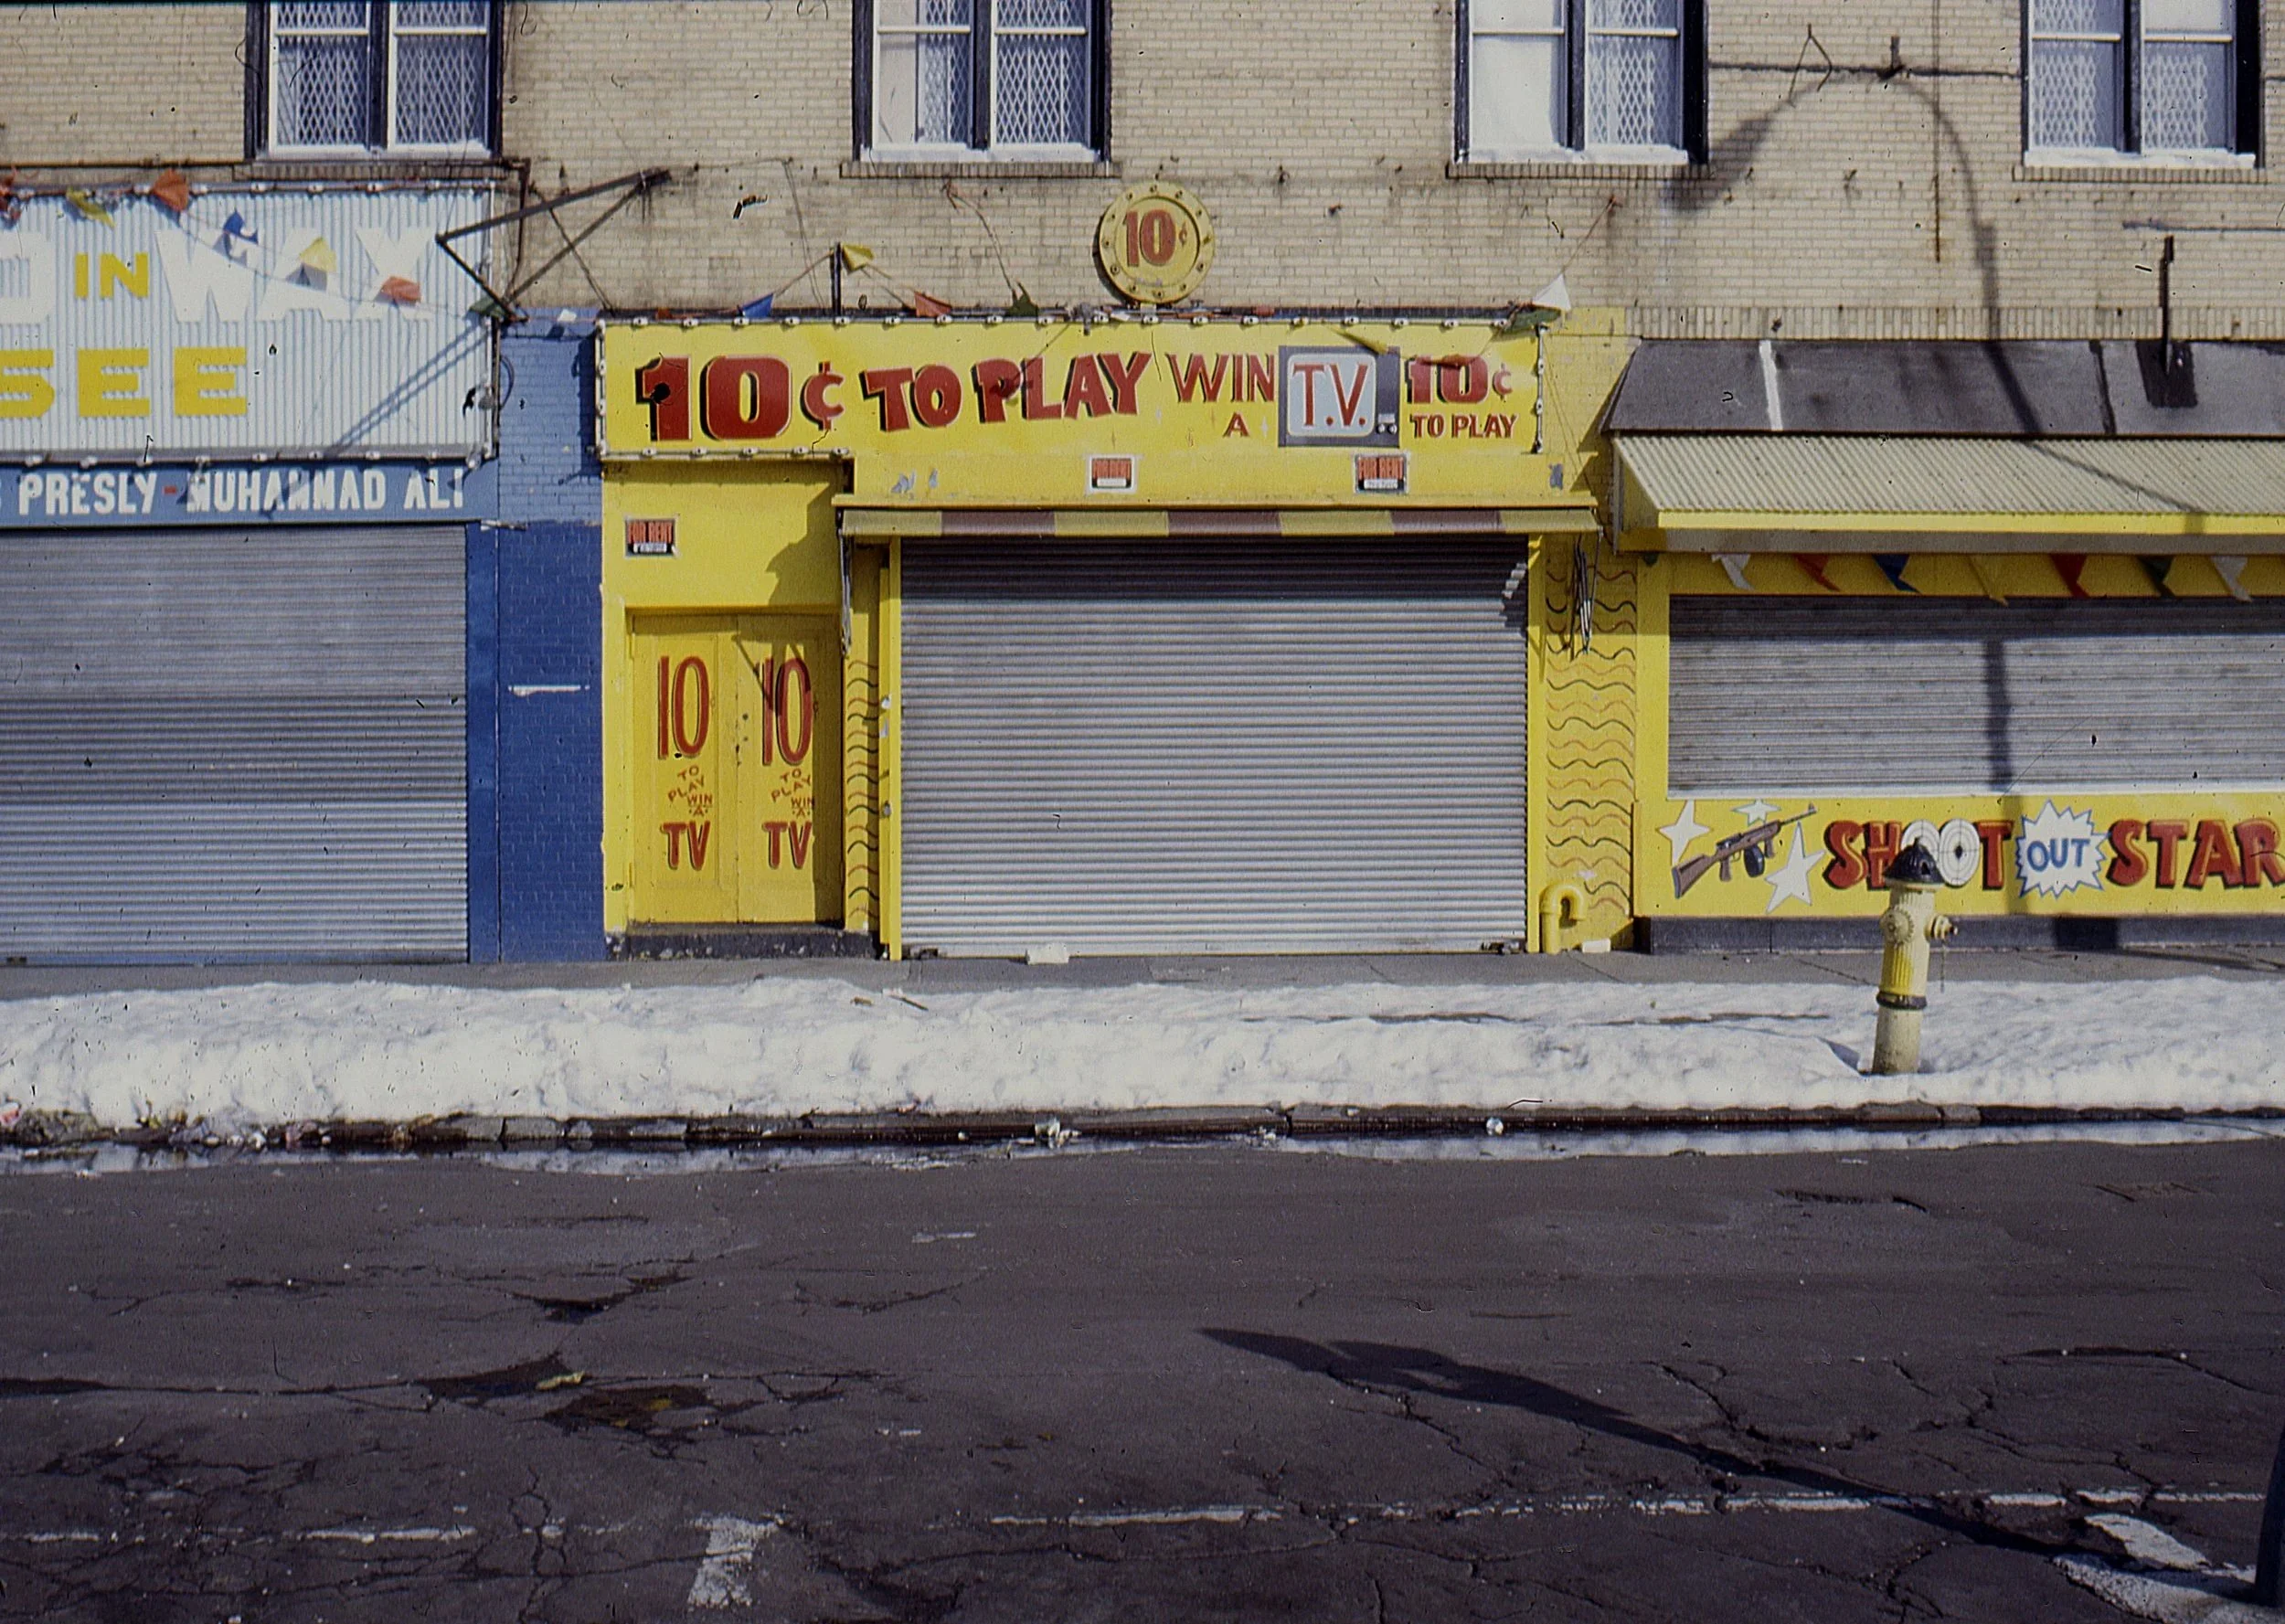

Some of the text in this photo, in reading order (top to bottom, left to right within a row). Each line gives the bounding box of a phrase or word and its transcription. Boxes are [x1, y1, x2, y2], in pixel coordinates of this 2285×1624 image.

[74, 252, 149, 300] IN
[154, 228, 436, 323] WAY
[0, 346, 248, 418] SEE
[635, 350, 1275, 442] 10¢ TO PLAY WIN
[1293, 361, 1368, 429] T.V.
[1223, 411, 1250, 438] A
[1408, 412, 1519, 440] TO PLAY
[18, 471, 157, 517] PRESLY
[186, 467, 387, 514] MUHAMMAD
[403, 466, 463, 509] ALI
[628, 520, 673, 544] FOR RENT
[657, 655, 710, 760] 10
[761, 656, 813, 767] 10
[667, 775, 705, 802] PLAY
[677, 765, 700, 782] TO
[771, 774, 812, 803] PLAY
[781, 768, 802, 783] TO
[687, 794, 713, 808] WIN
[791, 796, 815, 811] WIN
[660, 821, 711, 871] TV
[761, 821, 813, 869] TV
[2026, 836, 2089, 874] OUT
[2106, 818, 2285, 890] STAR
